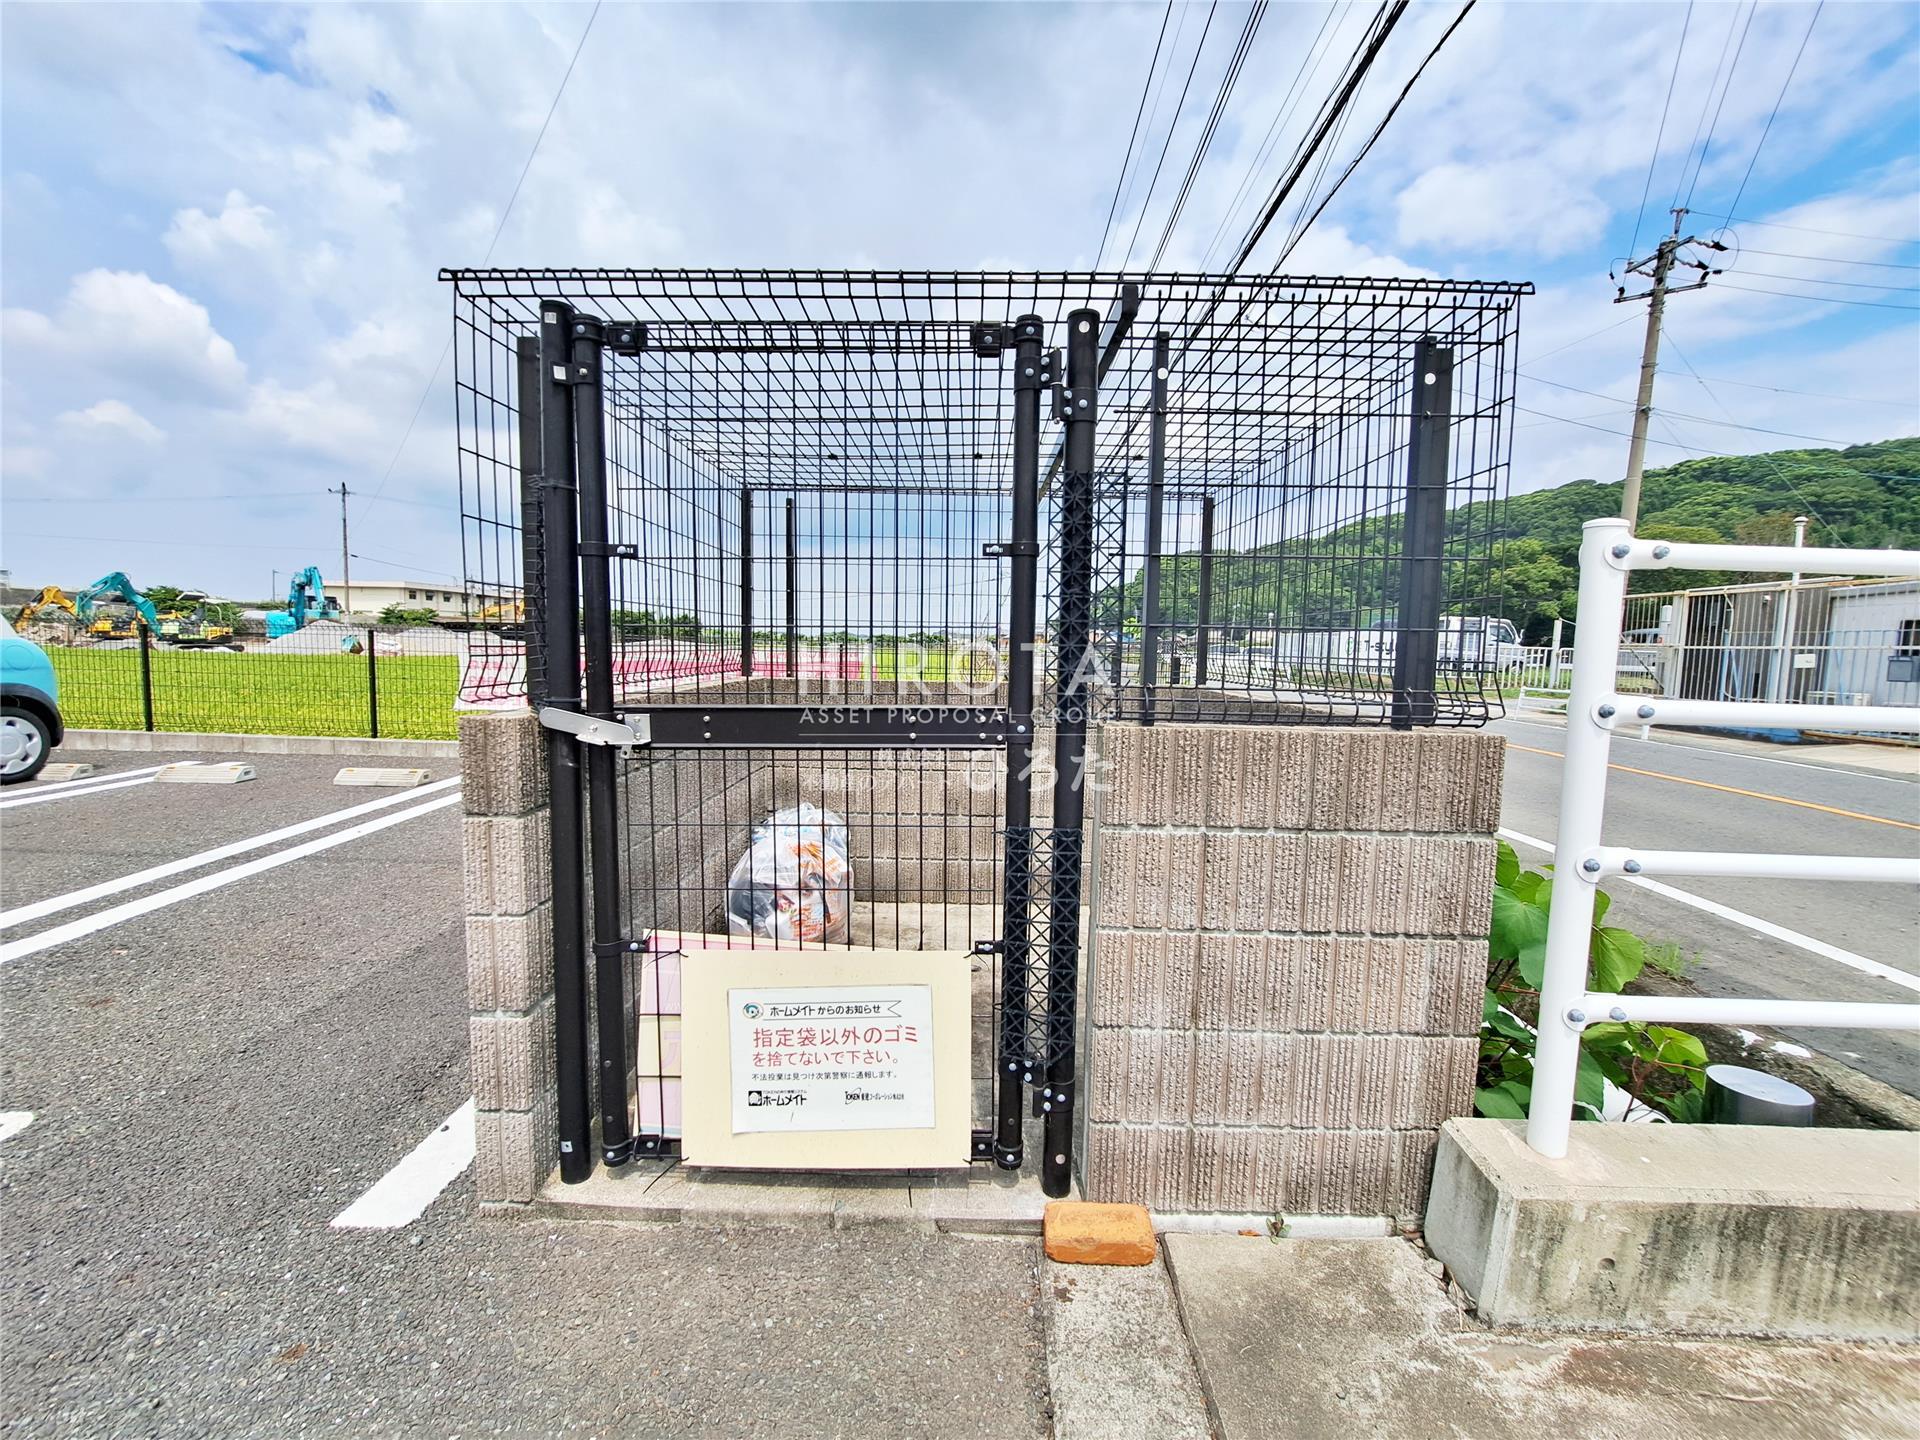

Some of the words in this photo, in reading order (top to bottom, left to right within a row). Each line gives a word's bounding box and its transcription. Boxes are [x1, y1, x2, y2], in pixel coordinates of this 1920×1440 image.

[752, 1024, 919, 1049] 指定袋以外のゴミ
[752, 1049, 898, 1068] を捨てないで下さい。
[762, 1093, 807, 1106] ホームメイト
